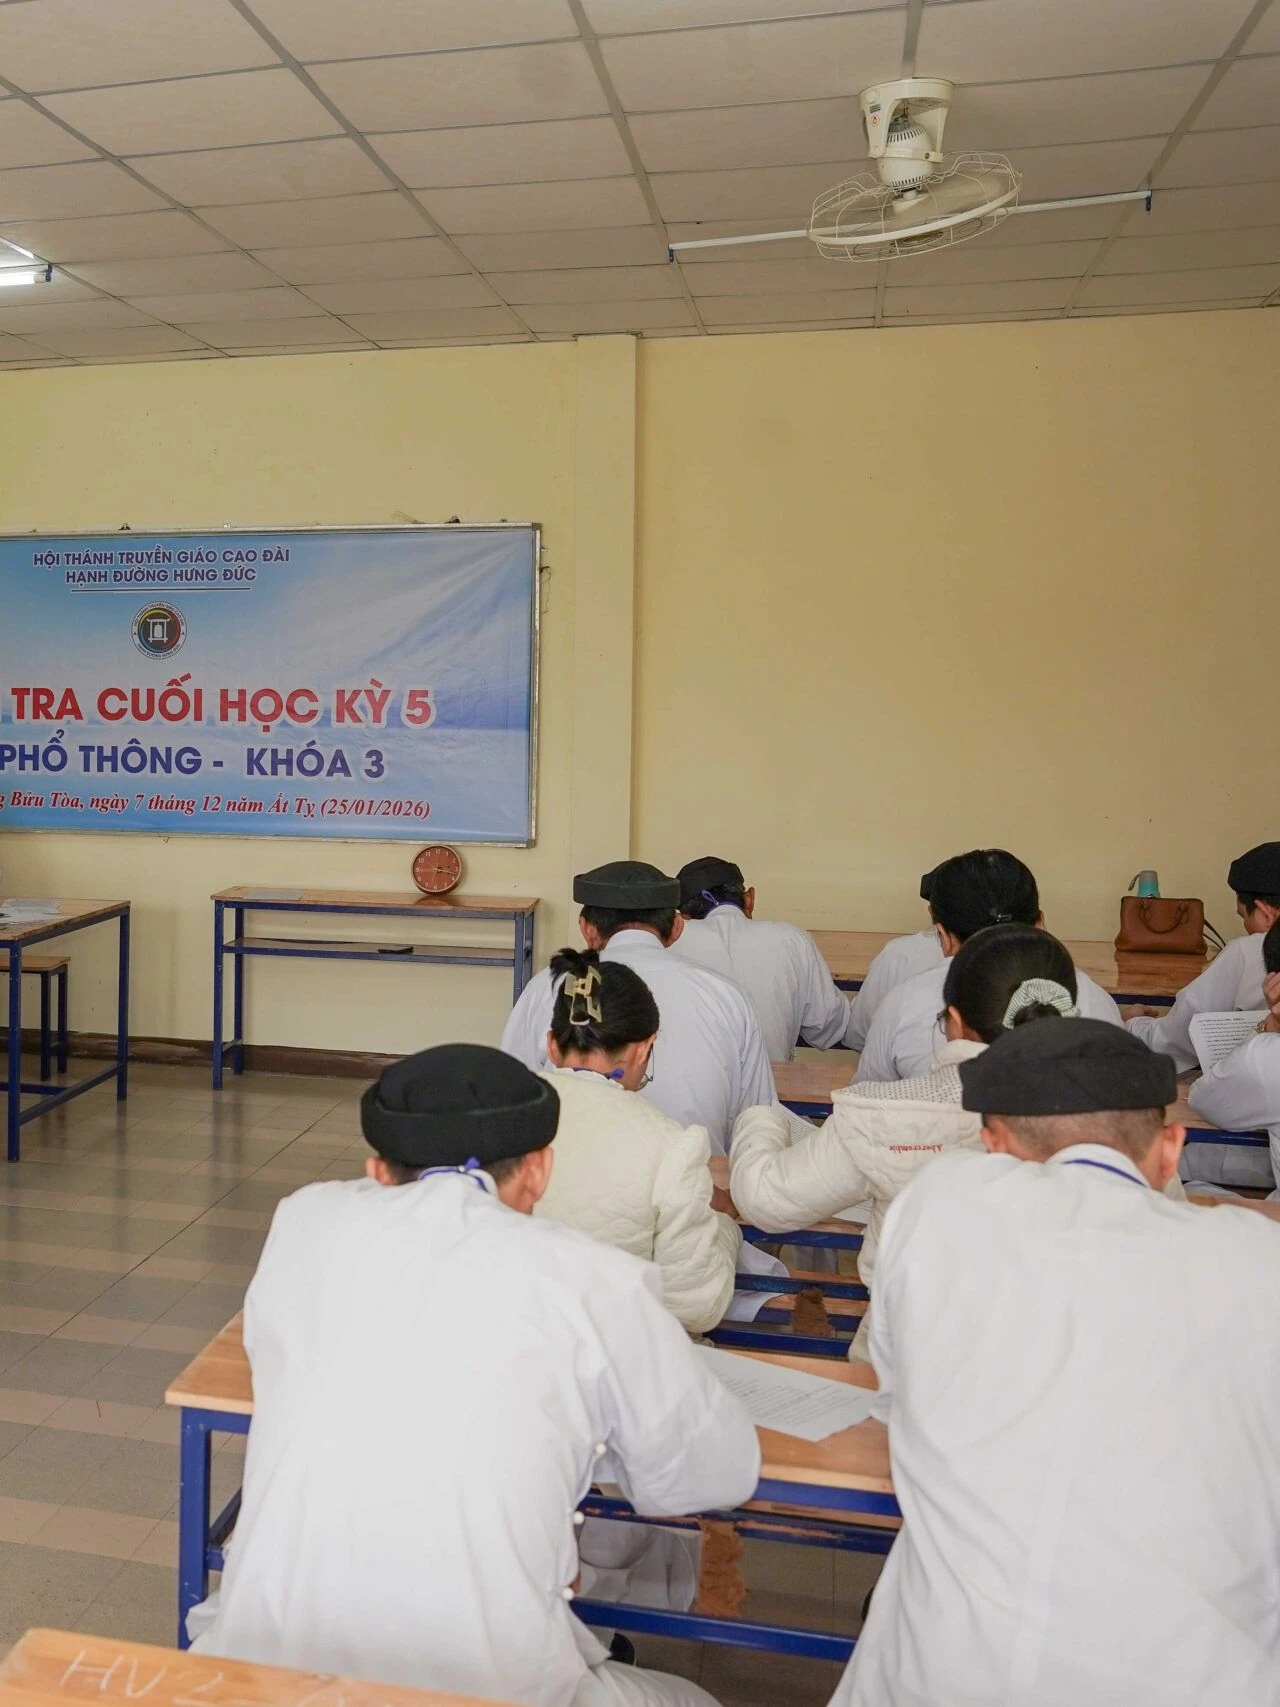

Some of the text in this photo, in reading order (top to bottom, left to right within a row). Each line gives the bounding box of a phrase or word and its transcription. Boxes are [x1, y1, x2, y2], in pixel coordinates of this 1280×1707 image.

[33, 545, 290, 569] HỘI THÁNH TRUYỀN GIÁO CAO ĐÀI
[66, 565, 257, 587] HẠNH ĐƯỜNG HƯNG ĐỨC
[10, 687, 84, 720] TRA
[96, 672, 203, 722] CUỐI
[219, 688, 320, 733] HỌC
[336, 678, 392, 724] KỲ
[405, 689, 432, 725] 5
[78, 737, 203, 775] THÔNG
[246, 740, 353, 778] KHÓA
[364, 749, 385, 779] 3
[50, 792, 85, 811] Tòa,
[89, 794, 130, 813] ngày
[134, 794, 144, 809] 7
[148, 794, 197, 816] tháng
[201, 795, 221, 812] 12
[225, 797, 263, 813] năm
[320, 798, 431, 820] (25/01/2026)
